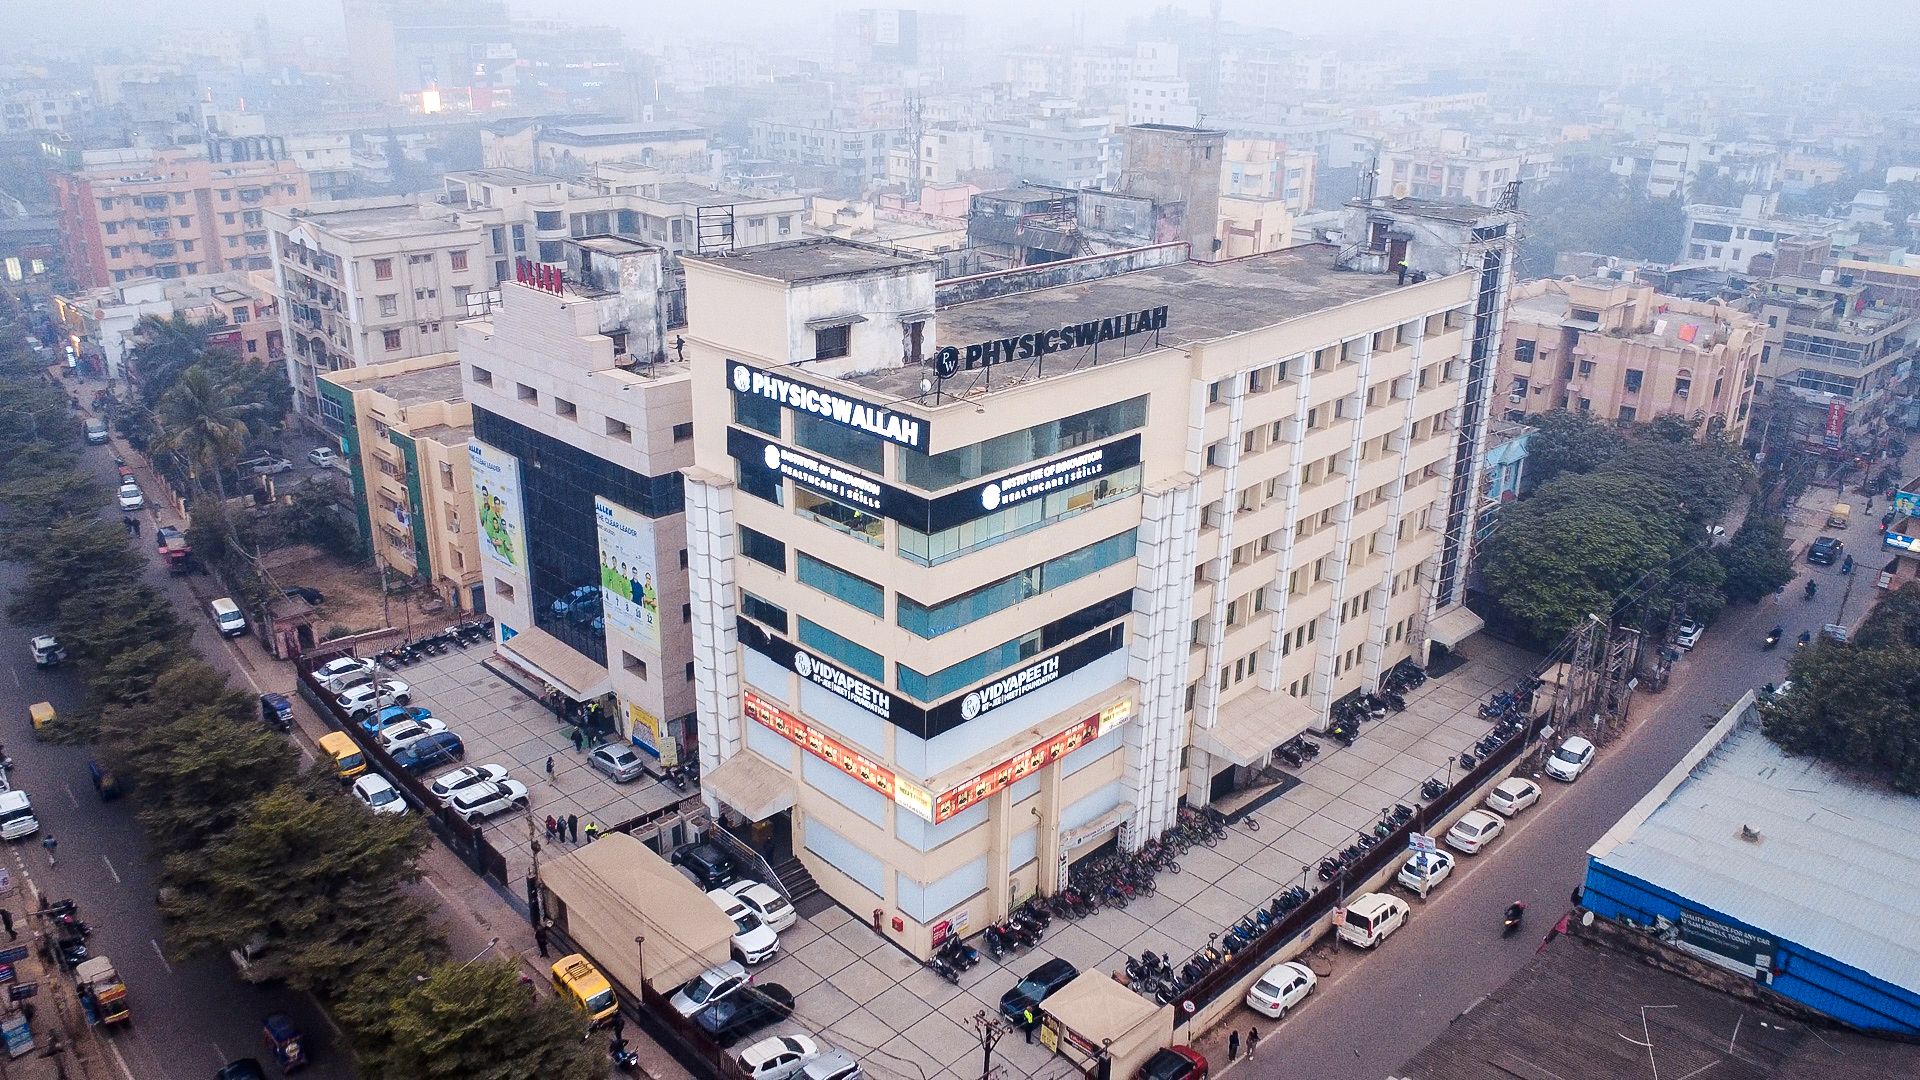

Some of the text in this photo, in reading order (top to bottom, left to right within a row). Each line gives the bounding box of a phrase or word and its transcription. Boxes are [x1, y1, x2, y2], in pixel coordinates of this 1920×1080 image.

[965, 305, 1168, 370] PHYSICSWALLAH
[752, 372, 918, 446] PHYSICSWALLAH
[780, 463, 839, 493] HEALTHCARE
[1044, 464, 1055, 477] OF
[1001, 476, 1064, 504] HEALTHCARE
[595, 502, 613, 516] ALLEN
[605, 517, 619, 530] CLEAR
[619, 524, 637, 537] LEADER
[811, 658, 890, 710] VIDYAPEETH
[980, 656, 1059, 703] VIDYAPEETH
[1022, 670, 1058, 694] FOUNDATION
[851, 692, 890, 718] FOUNDATION
[1680, 911, 1704, 924] QUALITY
[1705, 919, 1729, 933] SERVICE
[1730, 927, 1743, 936] FOR
[1743, 932, 1756, 941] ANY
